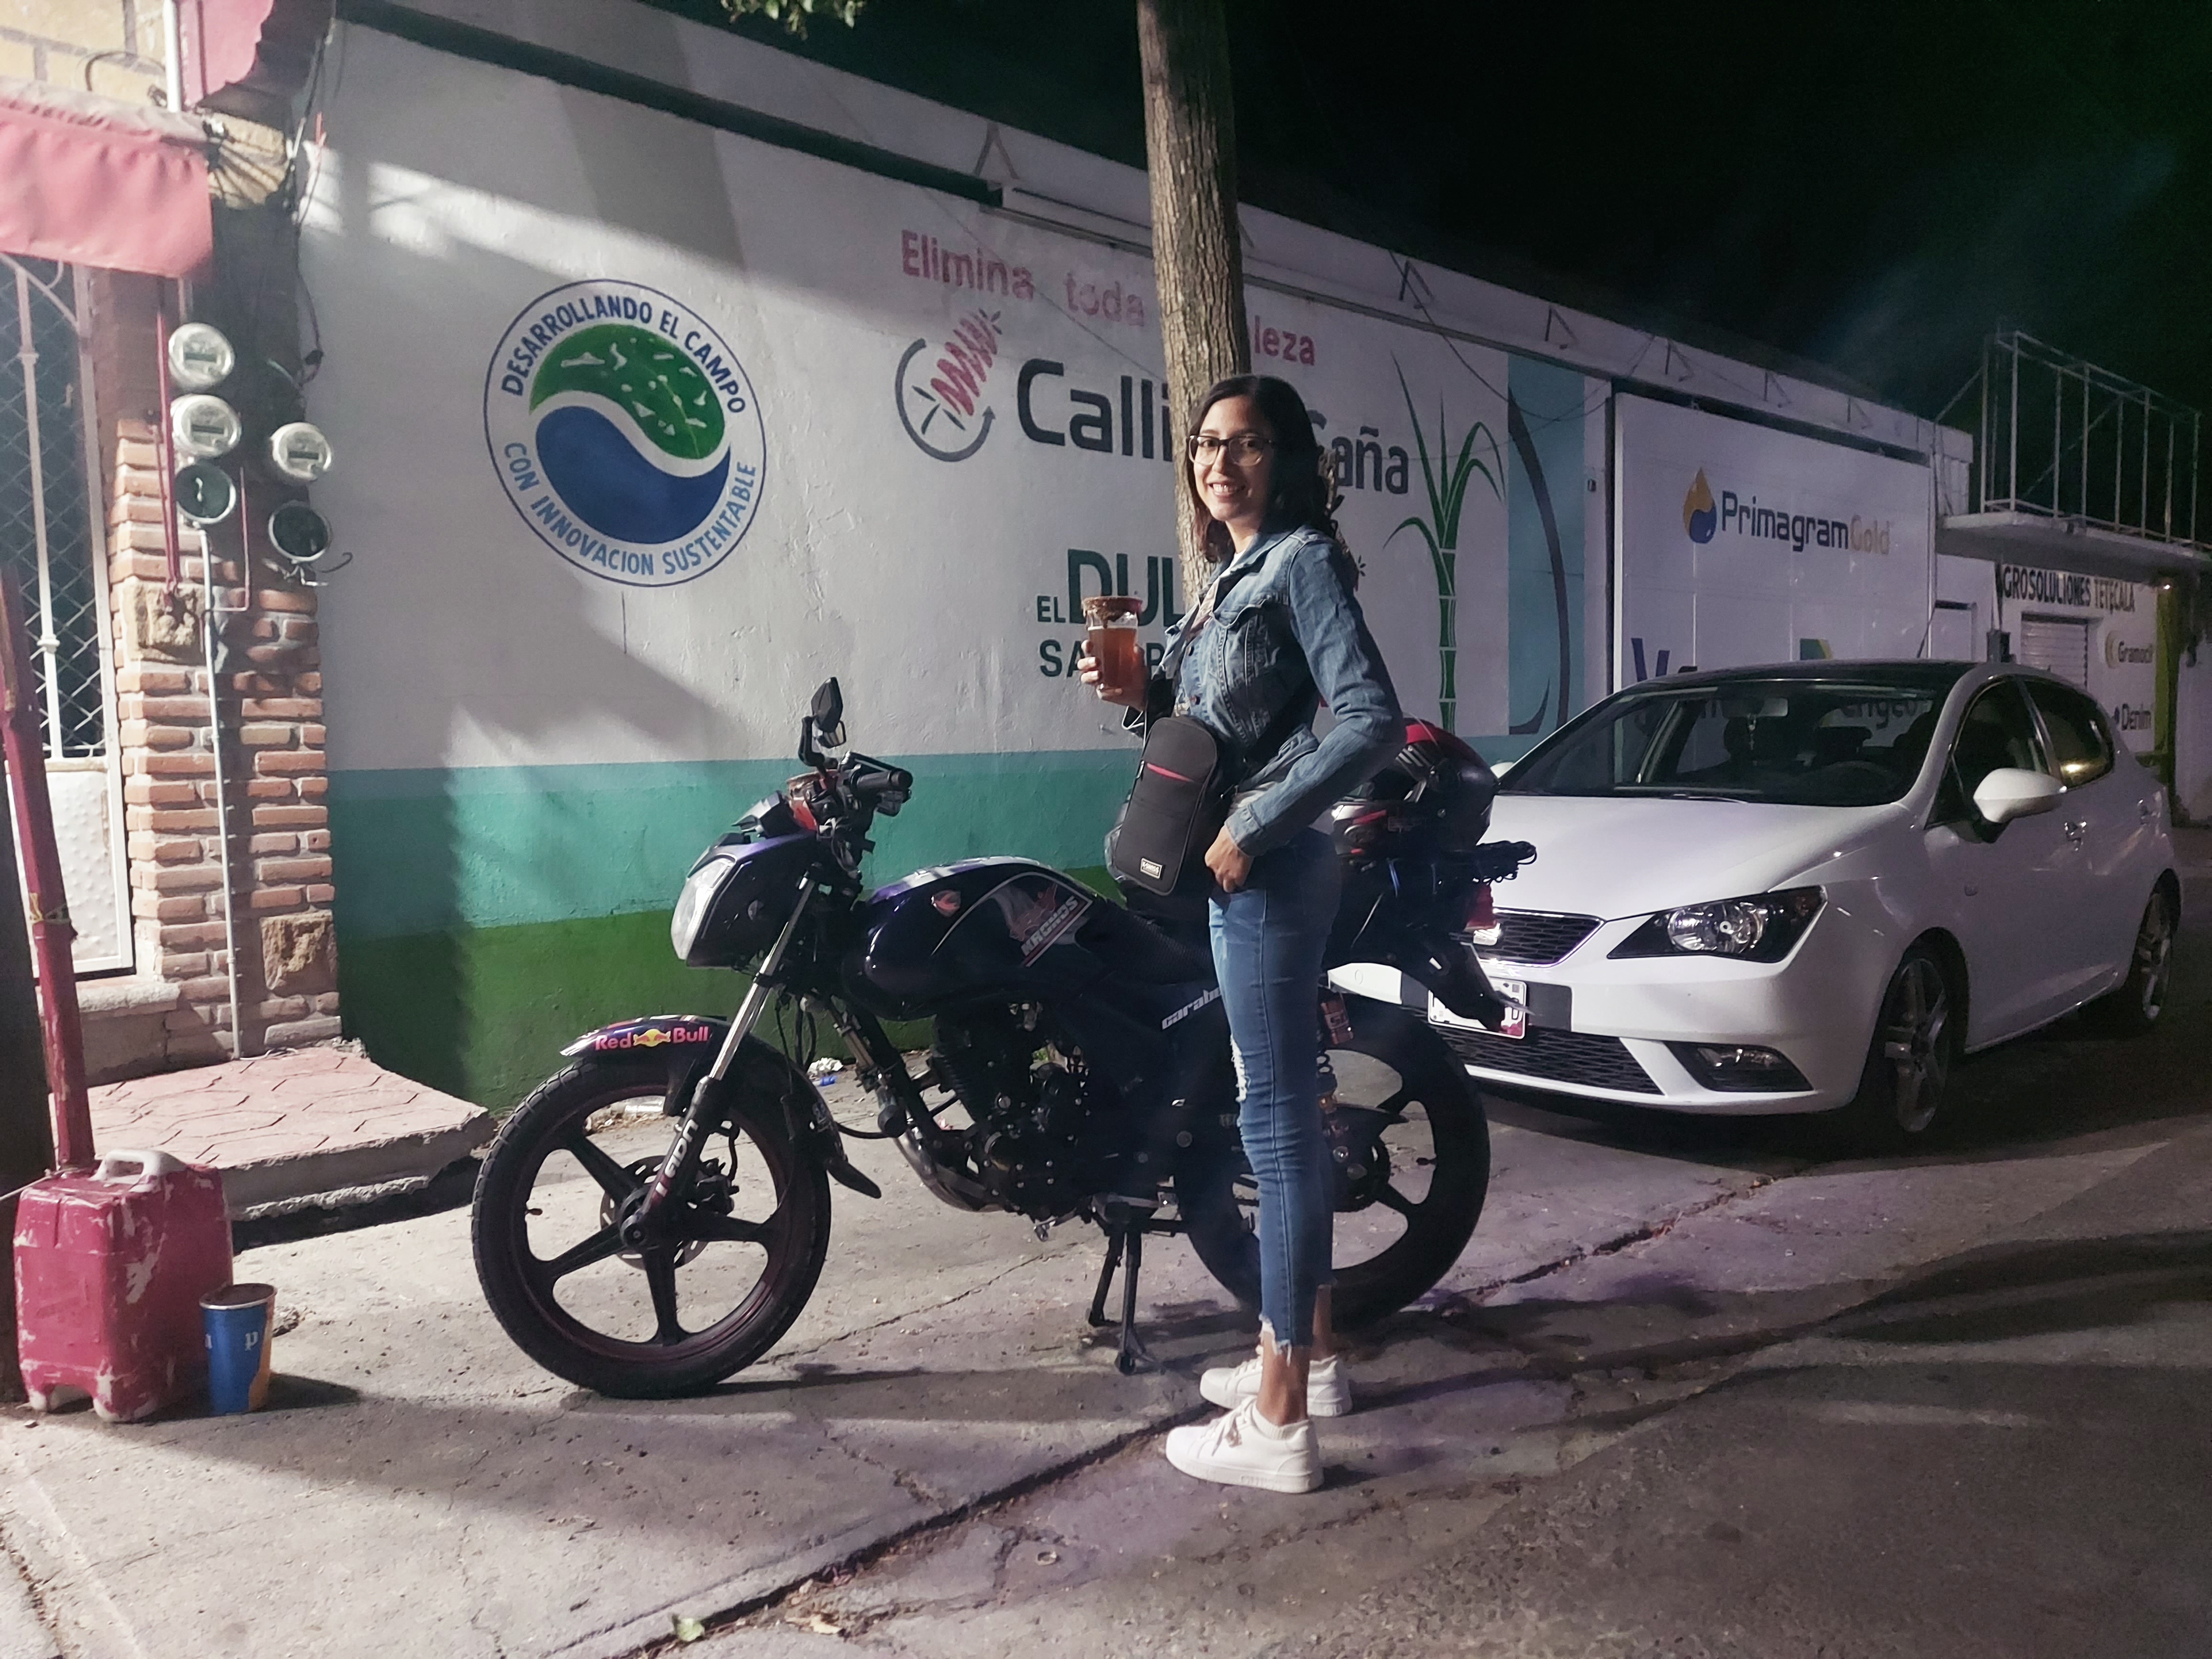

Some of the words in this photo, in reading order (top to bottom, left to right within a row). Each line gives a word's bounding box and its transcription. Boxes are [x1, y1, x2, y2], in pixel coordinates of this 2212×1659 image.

[901, 229, 1034, 300] Elimina
[1065, 273, 1145, 327] toda
[1254, 315, 1315, 366] leza
[501, 295, 652, 396] DESARROLLANDO
[659, 310, 678, 340] EL
[684, 331, 746, 413] CAMPO
[1017, 357, 1173, 462] Calli
[1305, 409, 1409, 495] aña
[504, 442, 539, 492] CON
[531, 496, 654, 575] INNOVACION
[663, 461, 756, 575] SUSTENTABLE
[1037, 595, 1066, 623] EL
[1067, 548, 1186, 628] DUL
[2002, 566, 2091, 607] GROSOLUCIONES
[1020, 896, 1080, 955] KRONOS
[595, 1031, 632, 1051] Red
[673, 1026, 709, 1044] Bull
